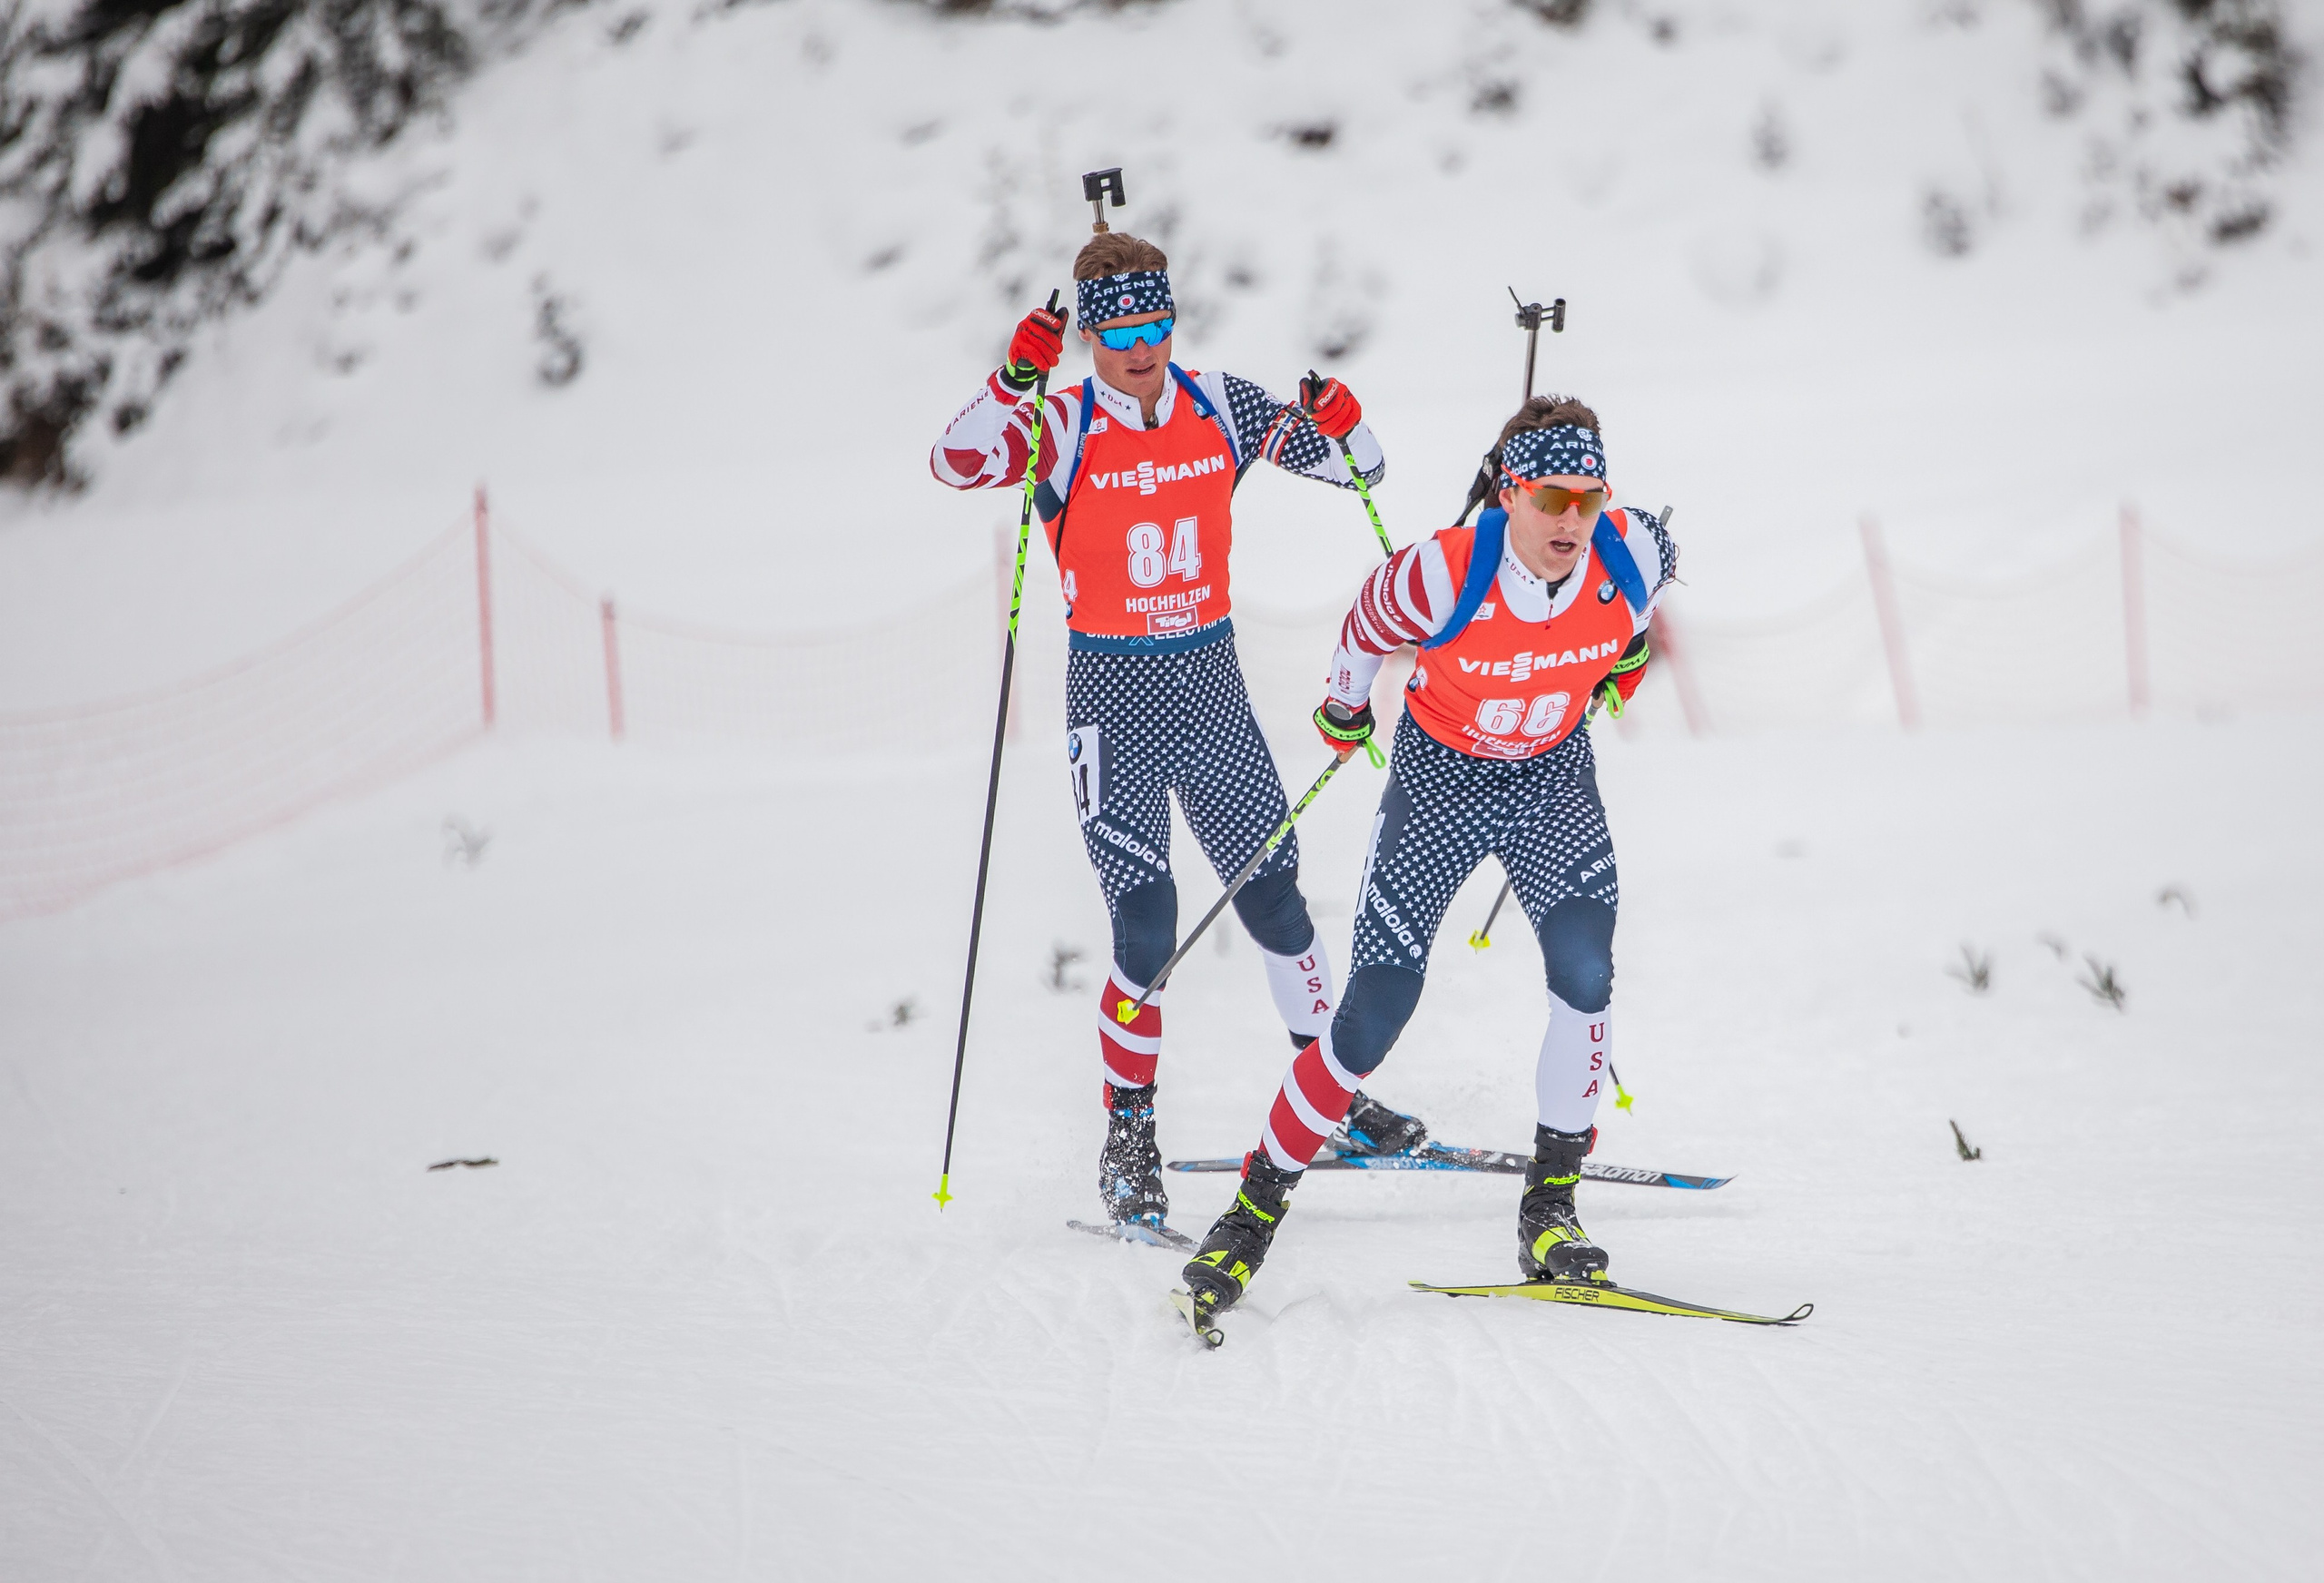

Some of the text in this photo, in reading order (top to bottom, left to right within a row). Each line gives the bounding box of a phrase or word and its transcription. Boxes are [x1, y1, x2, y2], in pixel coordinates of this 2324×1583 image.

[1092, 279, 1156, 300] ARIENS
[952, 390, 989, 427] ARIENS
[1090, 454, 1226, 496] VIESSMANN
[1126, 516, 1202, 588] 84
[1126, 584, 1211, 614] HOCHFILZEN
[1458, 638, 1618, 683] VIESSMANN
[1475, 691, 1571, 738] 66
[1093, 821, 1157, 865] maloja
[1366, 881, 1415, 947] maloja
[1296, 954, 1330, 1014] USA
[1581, 1022, 1605, 1097] USA
[1580, 1163, 1663, 1184] salomon
[1554, 1286, 1600, 1303] FISCHER
